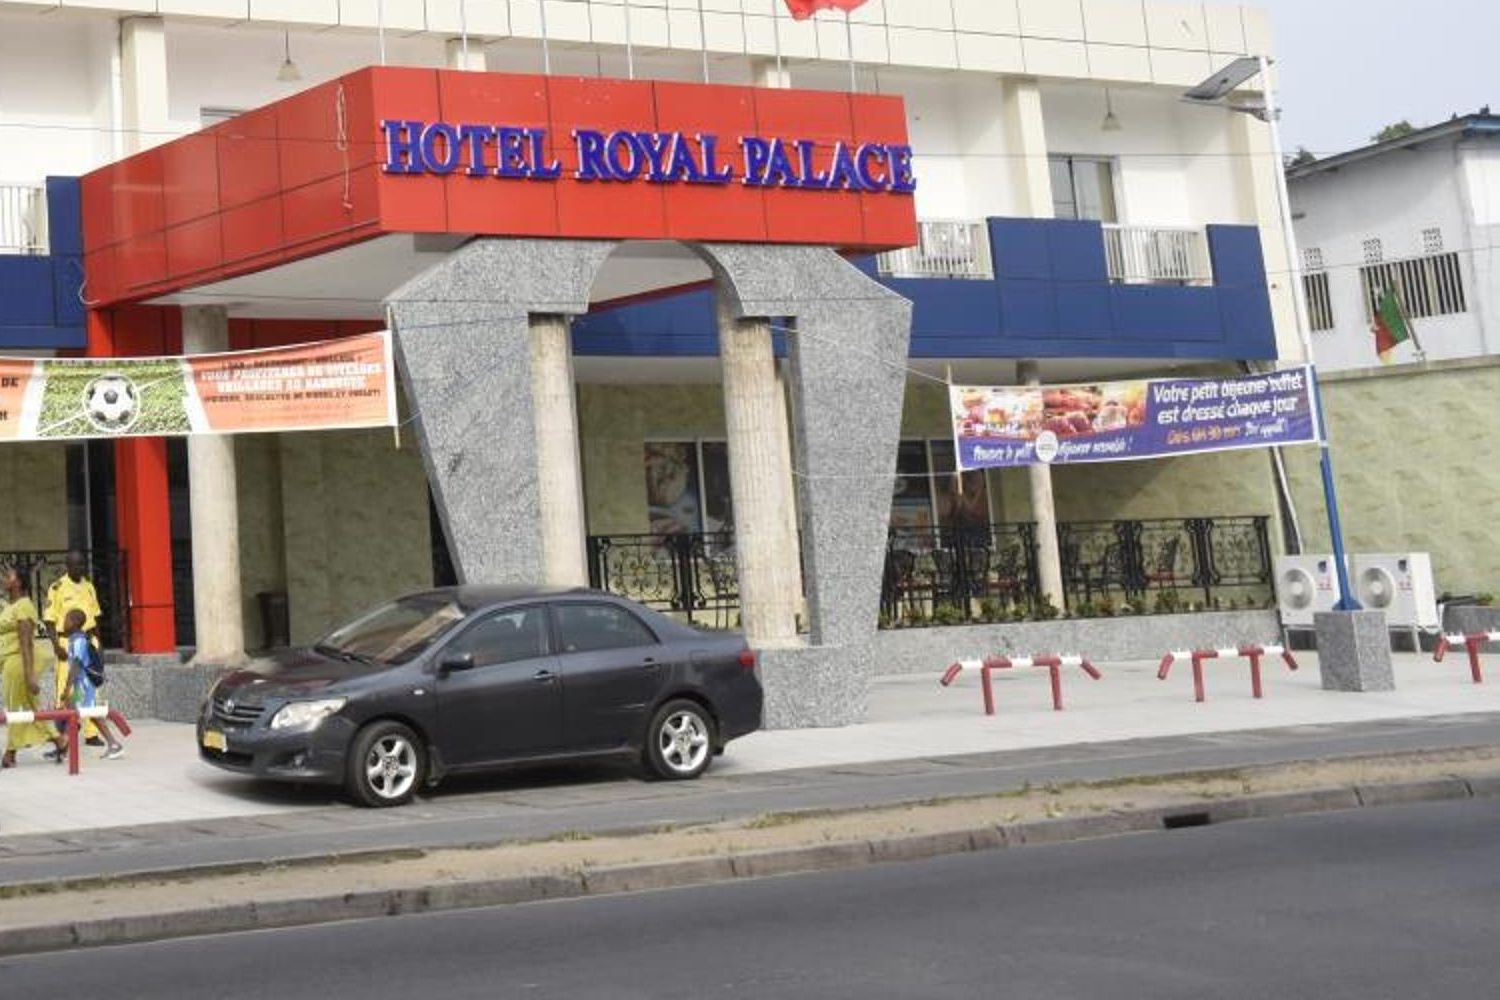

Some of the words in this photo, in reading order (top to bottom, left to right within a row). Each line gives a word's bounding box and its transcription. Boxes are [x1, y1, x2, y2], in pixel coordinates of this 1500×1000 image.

[380, 119, 562, 179] HOTEL
[571, 126, 734, 185] ROYAL
[738, 135, 917, 194] PALACE
[1, 376, 19, 388] DE
[1153, 384, 1189, 403] Votre
[1191, 381, 1218, 403] petit
[1157, 406, 1179, 424] est
[1227, 399, 1271, 419] chaque
[1271, 396, 1298, 416] jour
